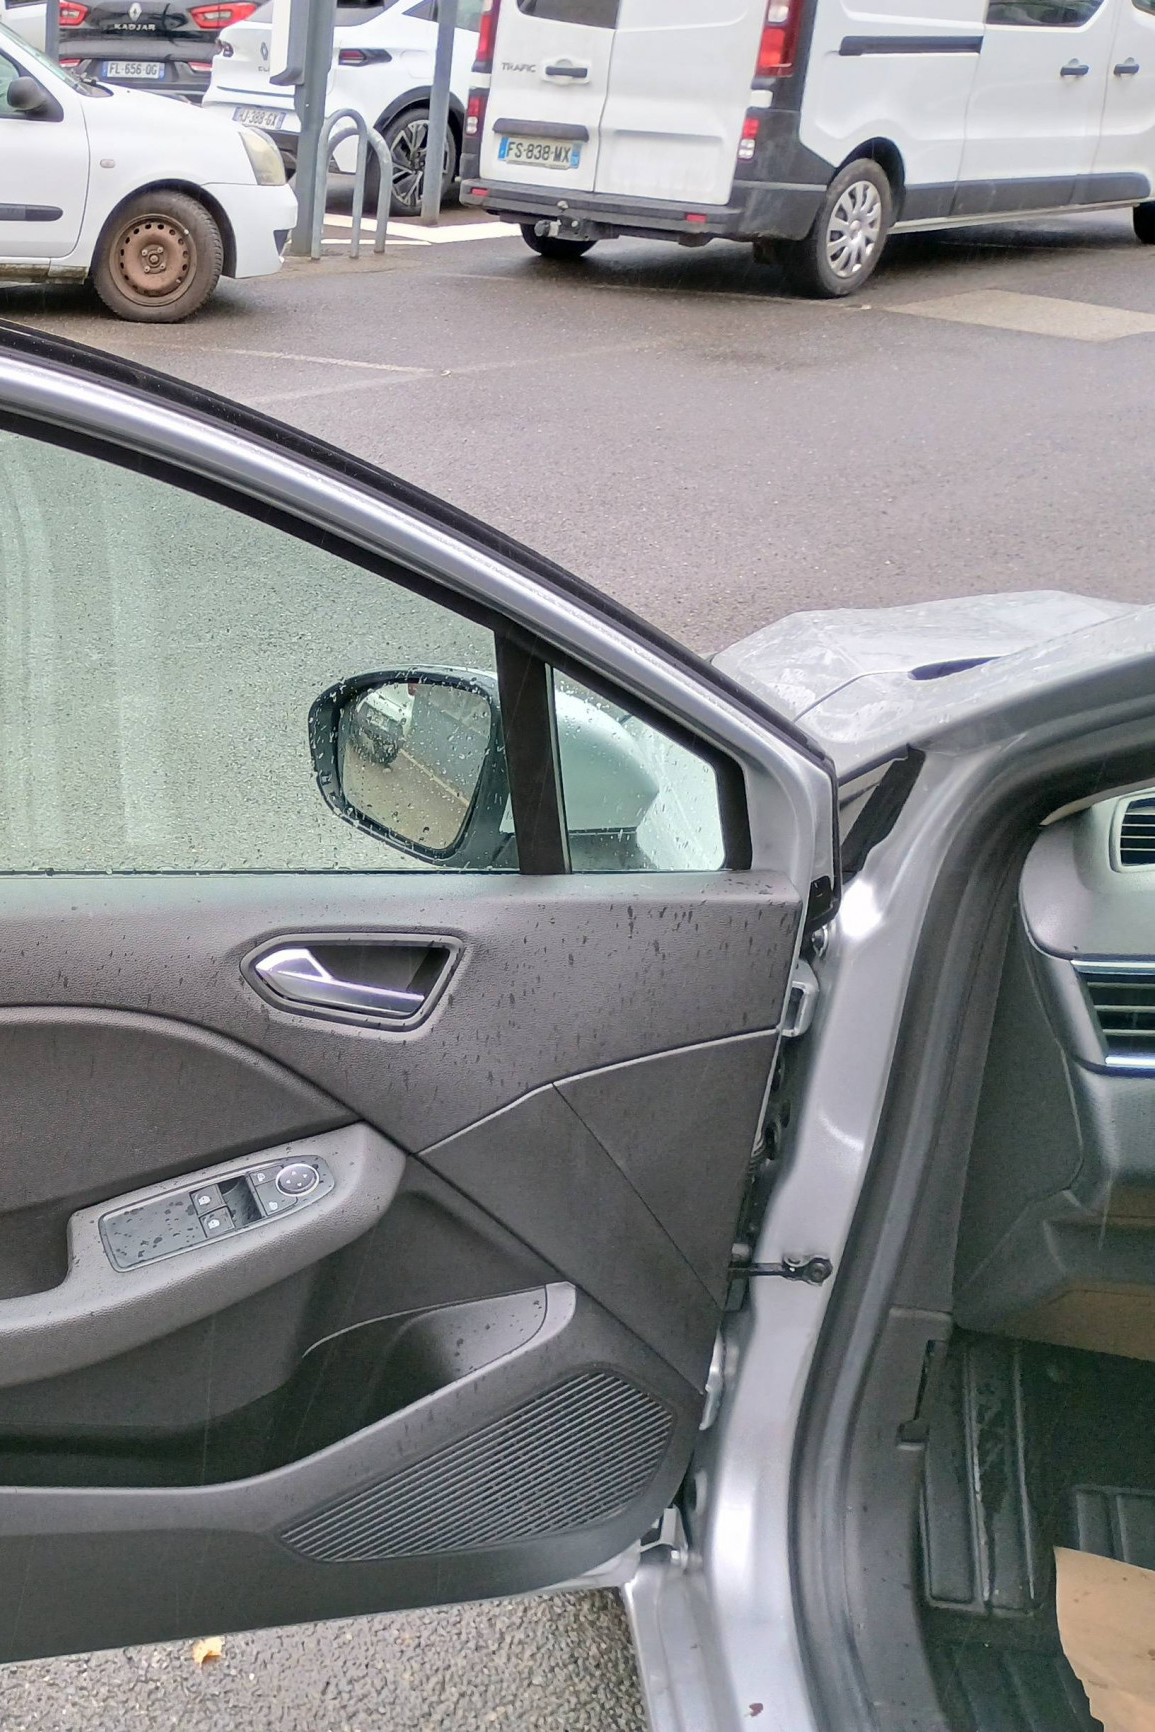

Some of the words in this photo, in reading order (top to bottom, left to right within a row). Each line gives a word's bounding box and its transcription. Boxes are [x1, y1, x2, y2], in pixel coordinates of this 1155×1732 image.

[113, 23, 156, 31] KADJAR
[109, 63, 157, 75] FL-656-QG
[502, 63, 536, 72] TRAFIC
[506, 142, 571, 162] FS-838-MX
